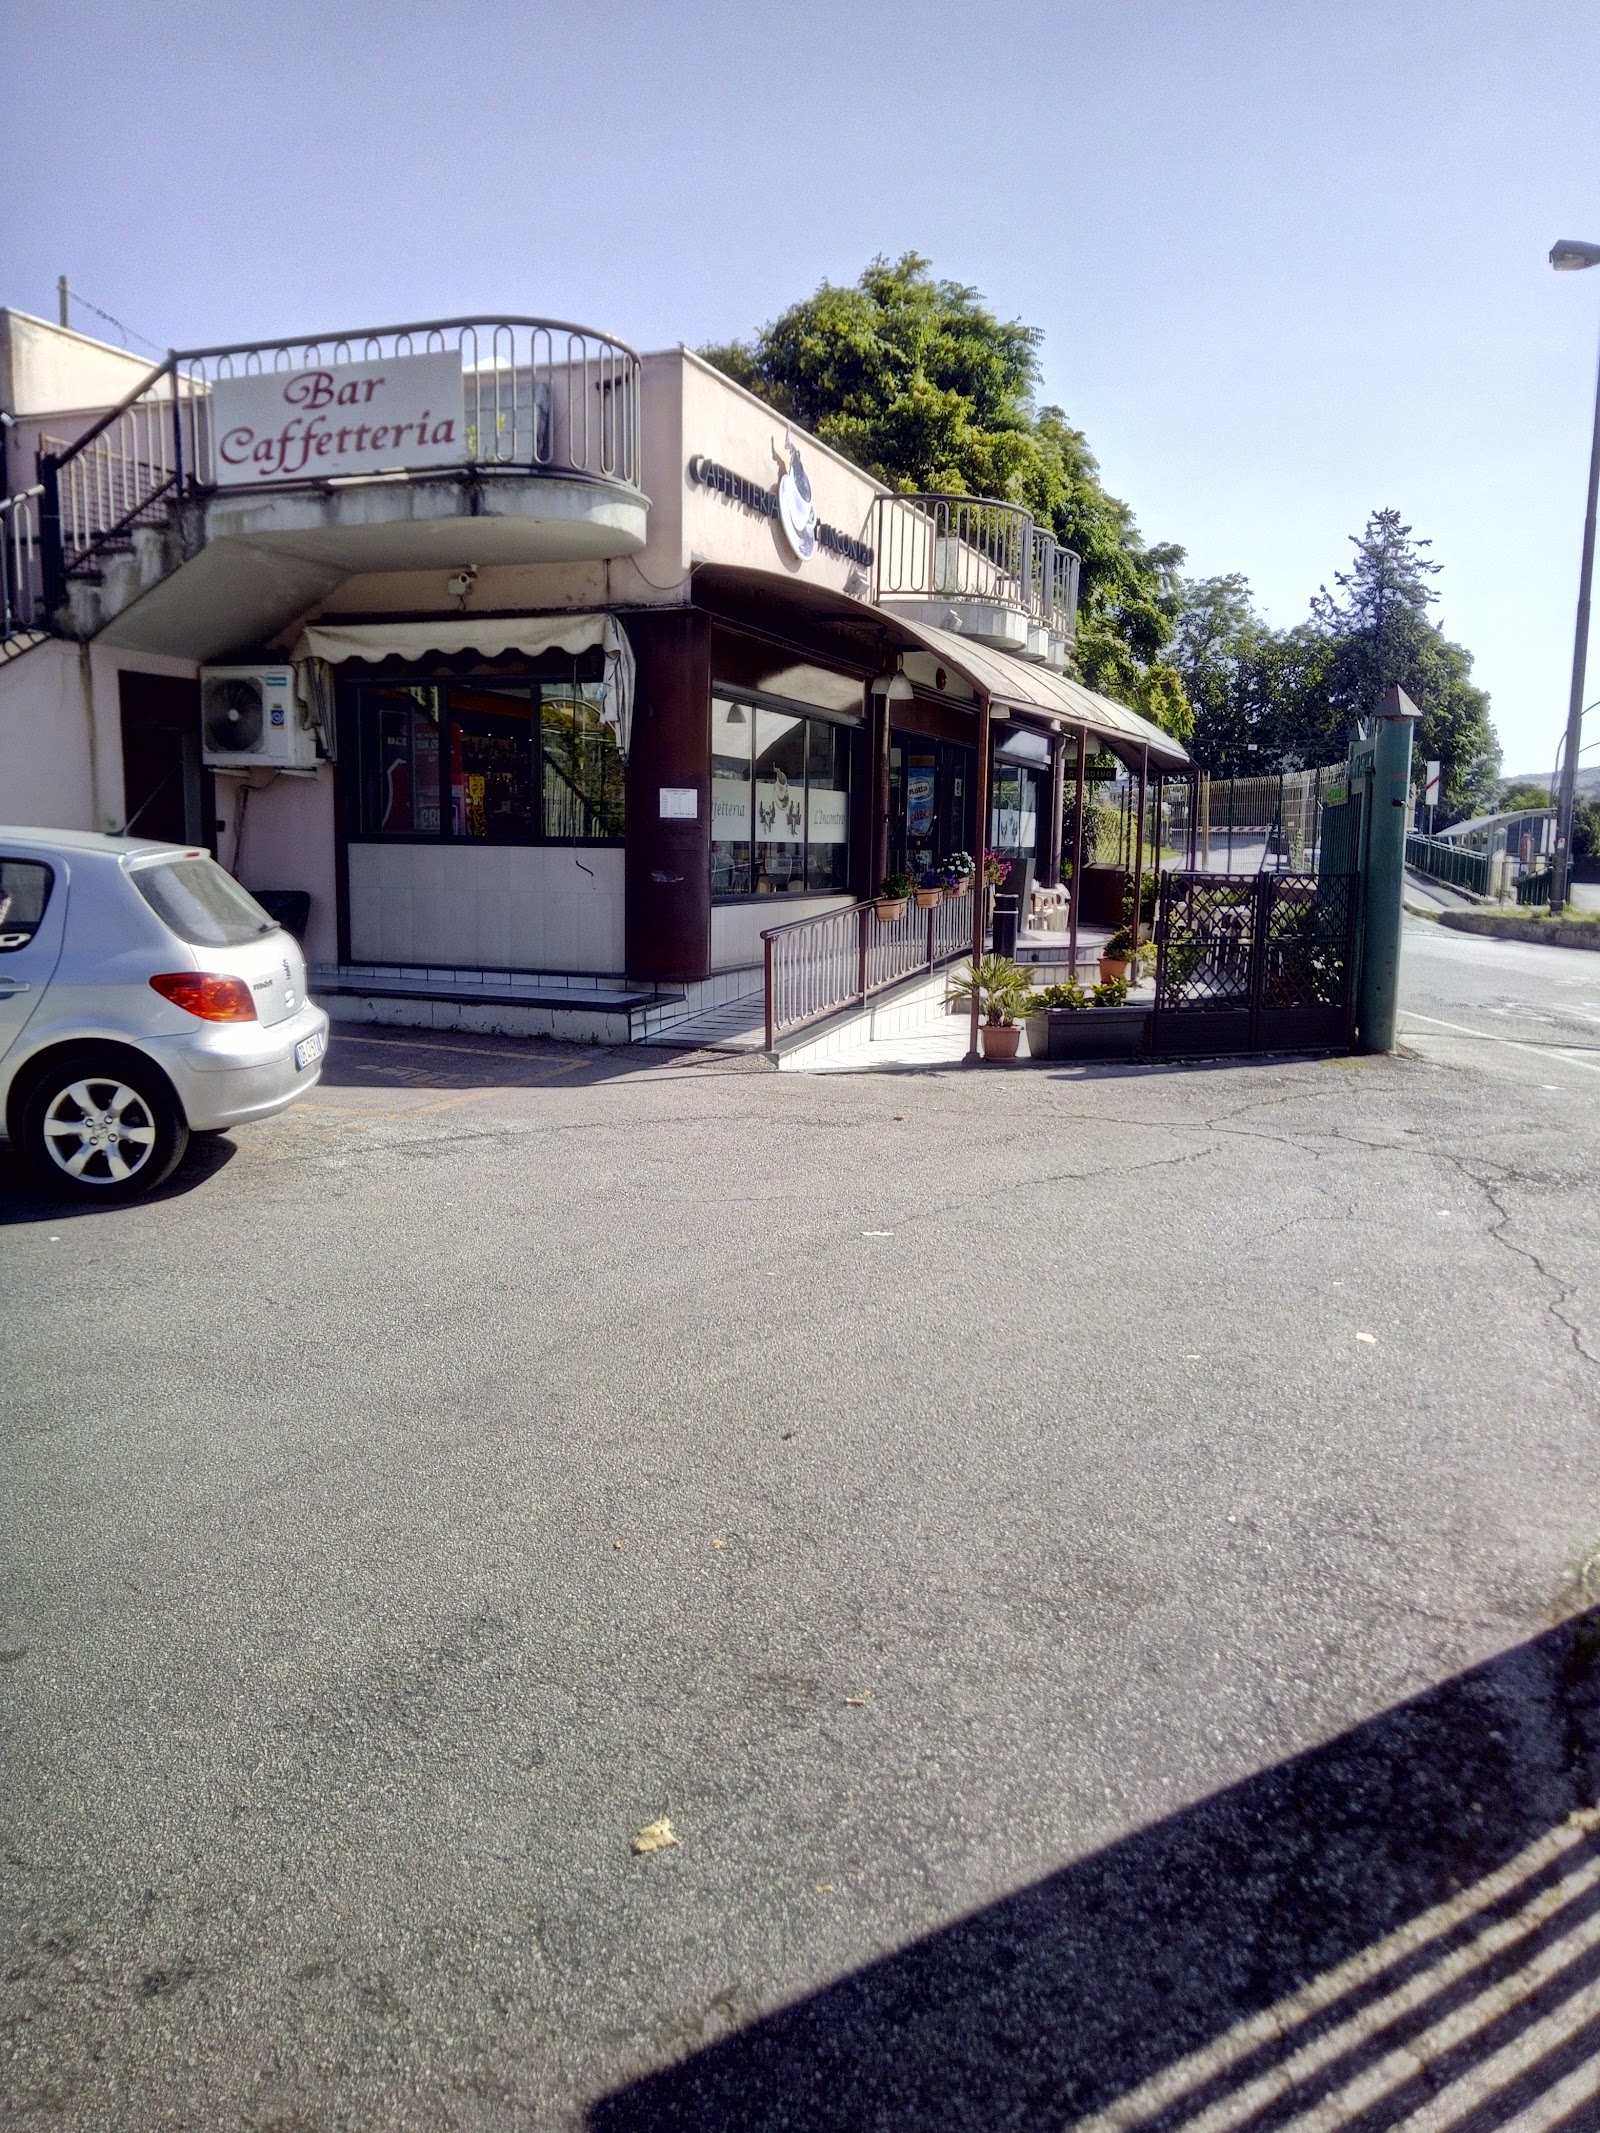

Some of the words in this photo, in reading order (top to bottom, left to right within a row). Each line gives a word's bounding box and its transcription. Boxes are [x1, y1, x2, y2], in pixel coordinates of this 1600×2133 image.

[283, 371, 386, 410] Bar
[219, 409, 456, 476] Caffetteria
[689, 454, 781, 520] CAFFETTERIA
[1068, 770, 1113, 778] GIRDINO
